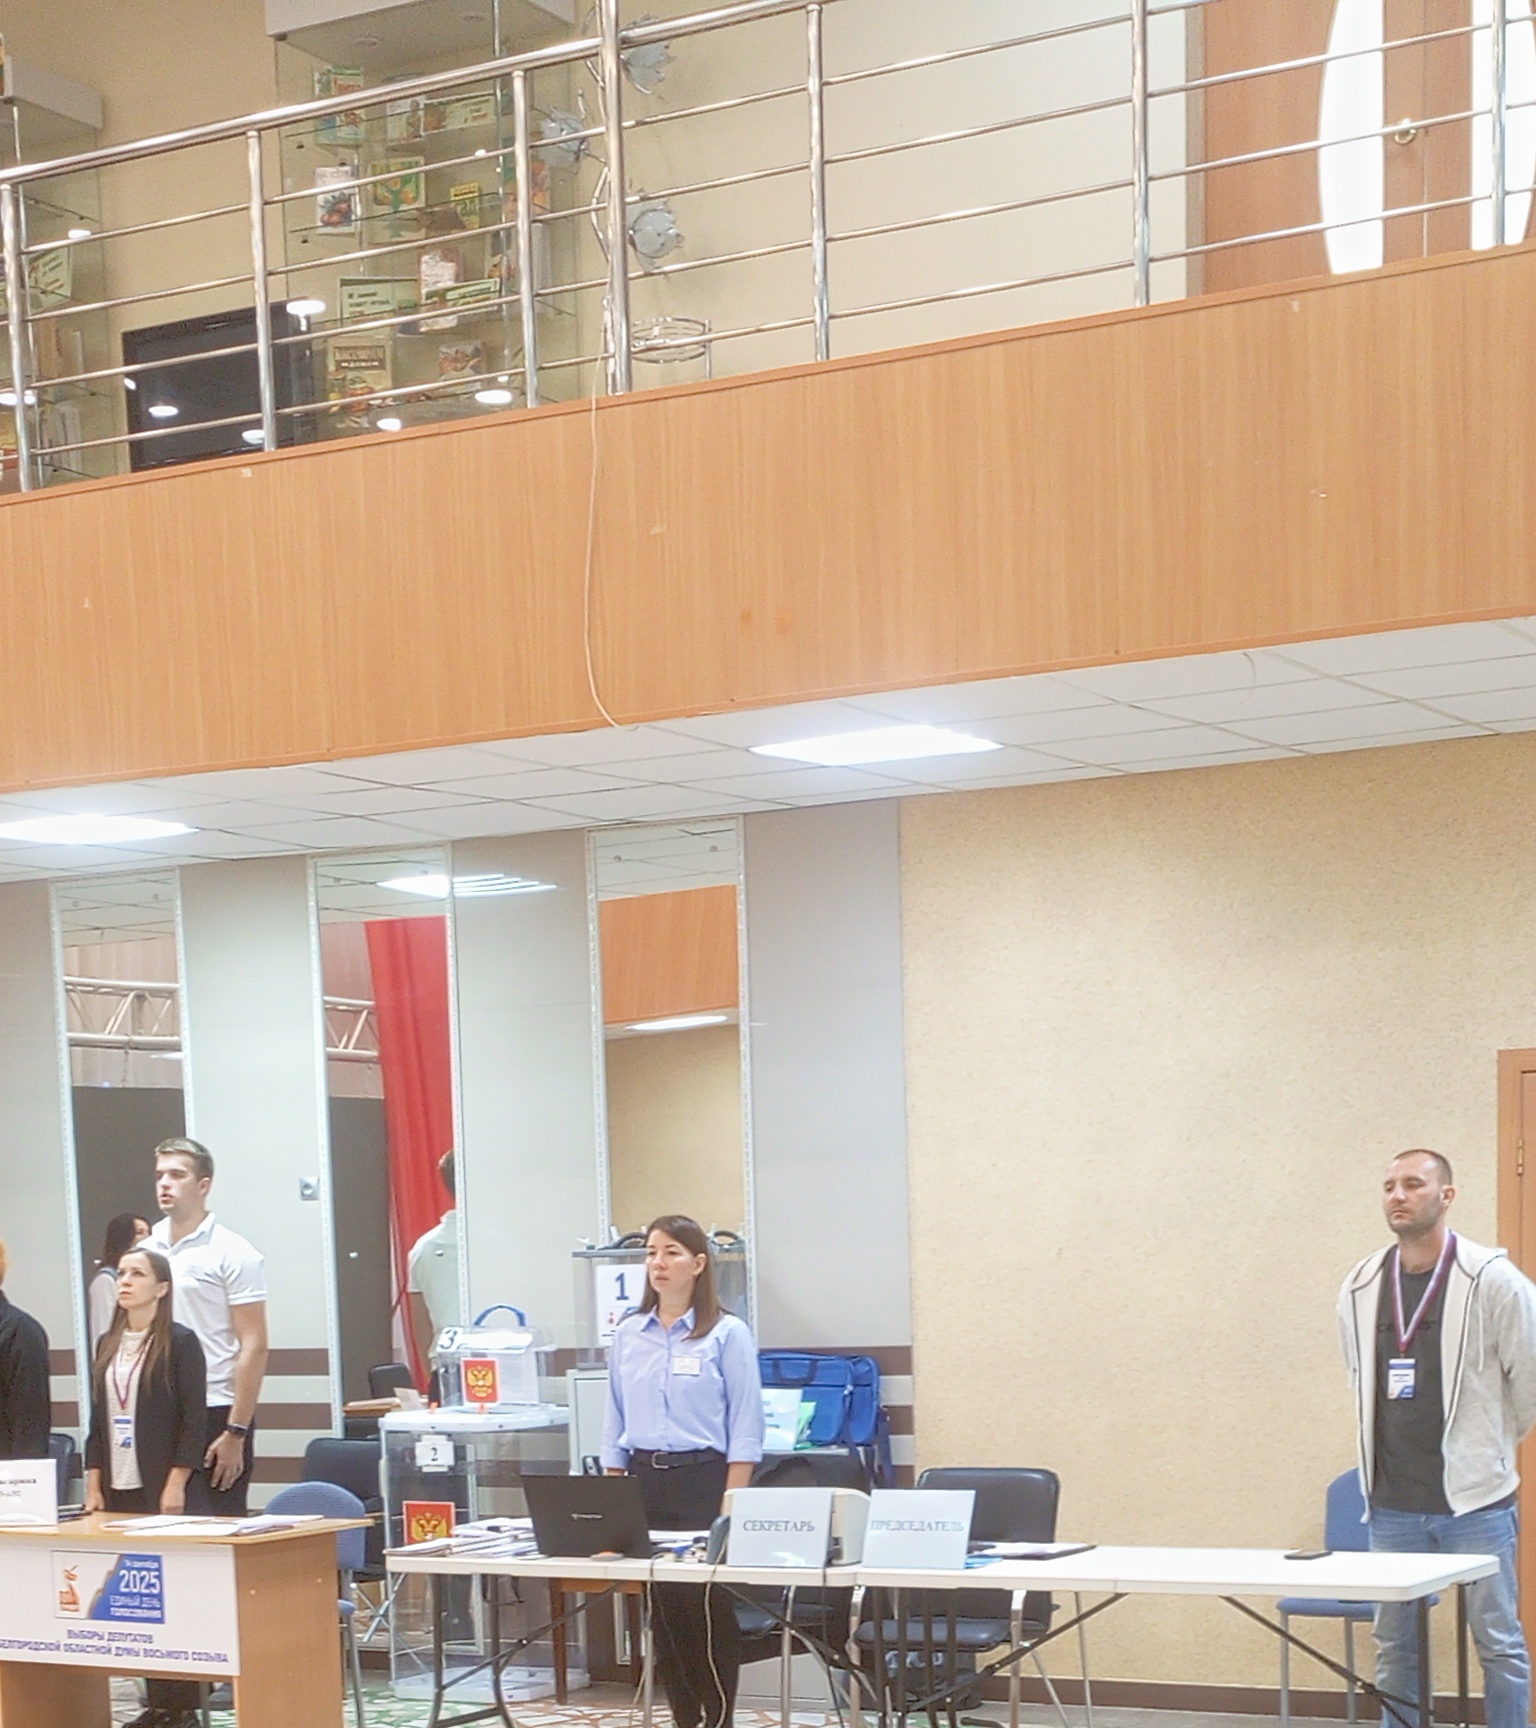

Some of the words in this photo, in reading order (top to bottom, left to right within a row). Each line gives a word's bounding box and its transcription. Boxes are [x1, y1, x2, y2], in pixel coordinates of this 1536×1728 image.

[615, 1272, 629, 1301] 1
[439, 1328, 458, 1350] 3
[430, 1447, 439, 1462] 2
[742, 1519, 815, 1533] СЕКРЕТАРЬ
[870, 1519, 965, 1533] ПРЕДСЕДАТЕЛЬ
[119, 1570, 161, 1594] 2025
[67, 1629, 105, 1641] ВЫБОРЫ
[107, 1631, 154, 1644] ДЕПУТАТОВ
[191, 1651, 229, 1663] СОЗЫВА
